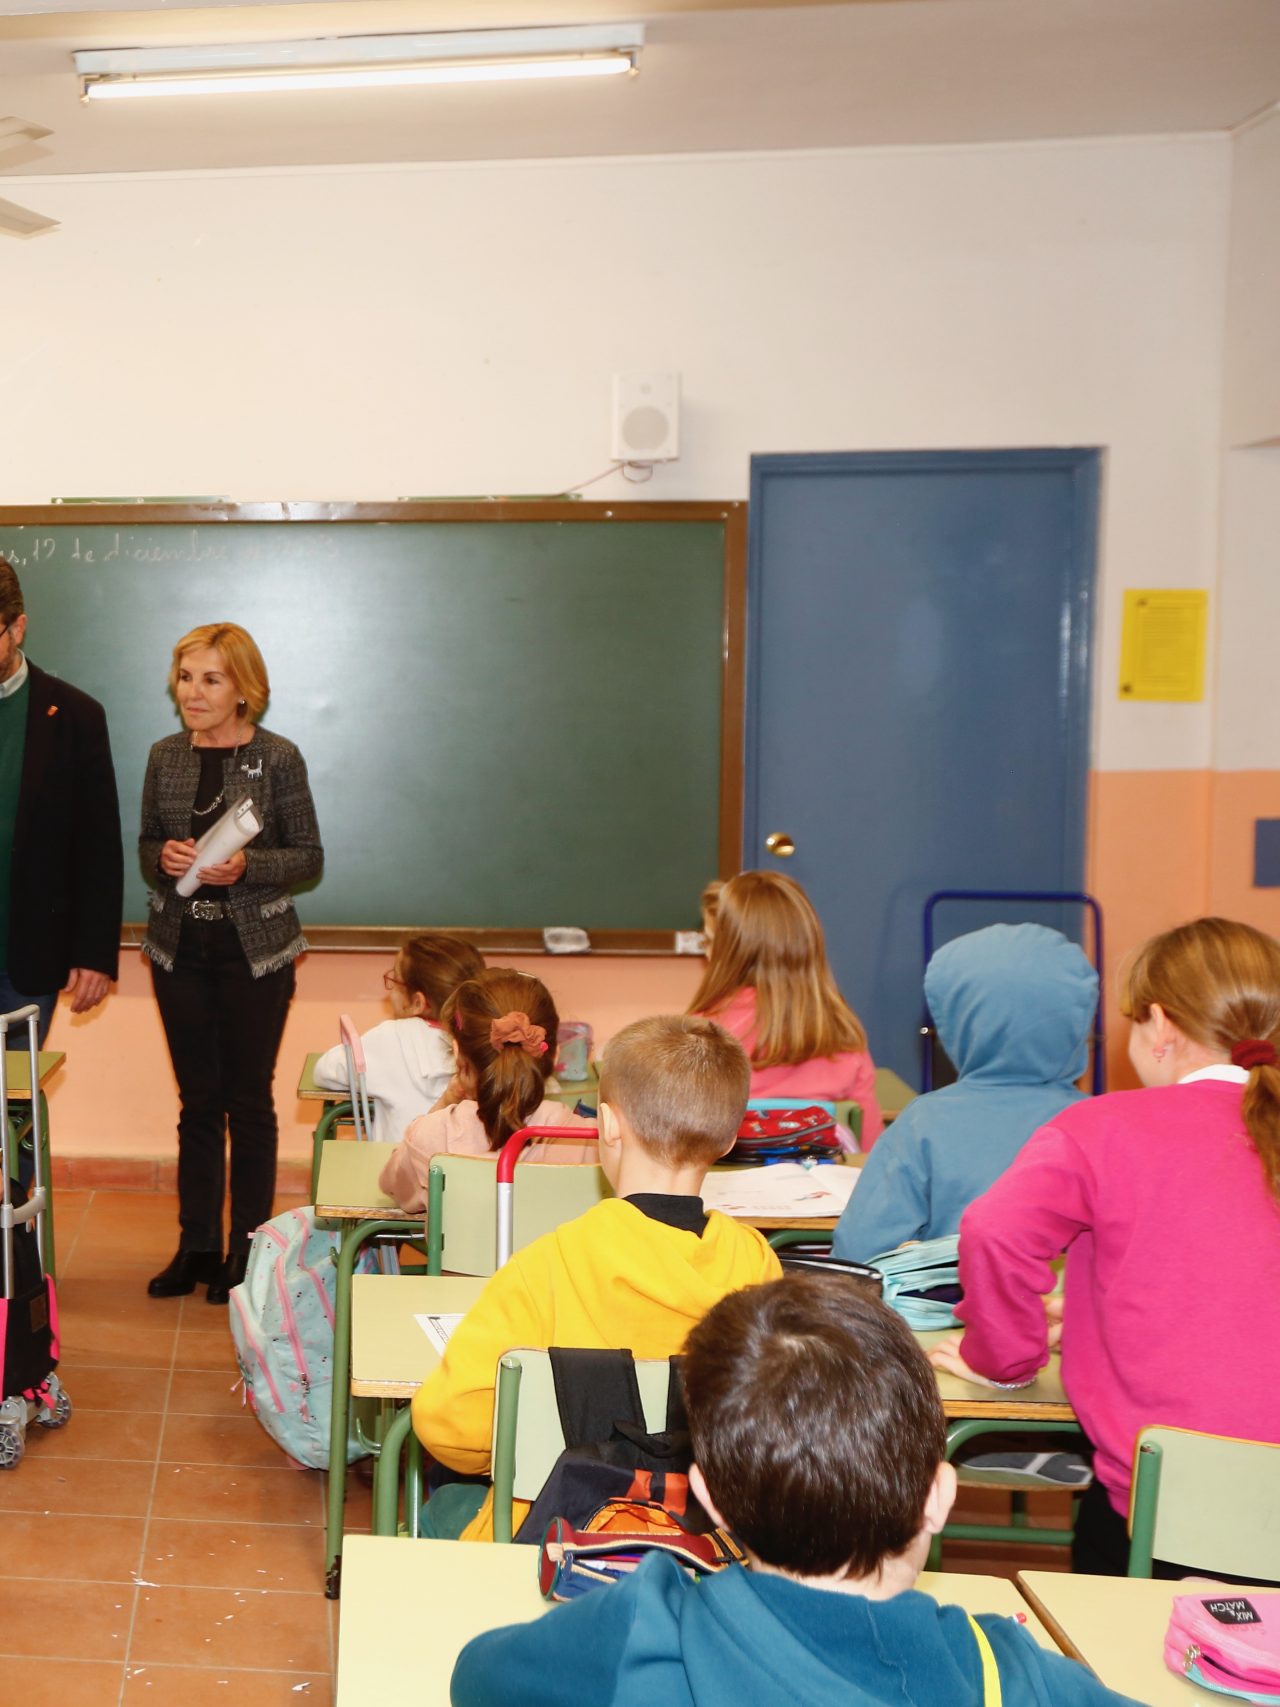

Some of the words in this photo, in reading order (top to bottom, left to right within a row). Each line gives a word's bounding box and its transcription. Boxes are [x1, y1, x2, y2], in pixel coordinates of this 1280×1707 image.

[71, 537, 95, 562] de
[1210, 1601, 1246, 1612] MATCH
[1236, 1611, 1254, 1621] MIX
